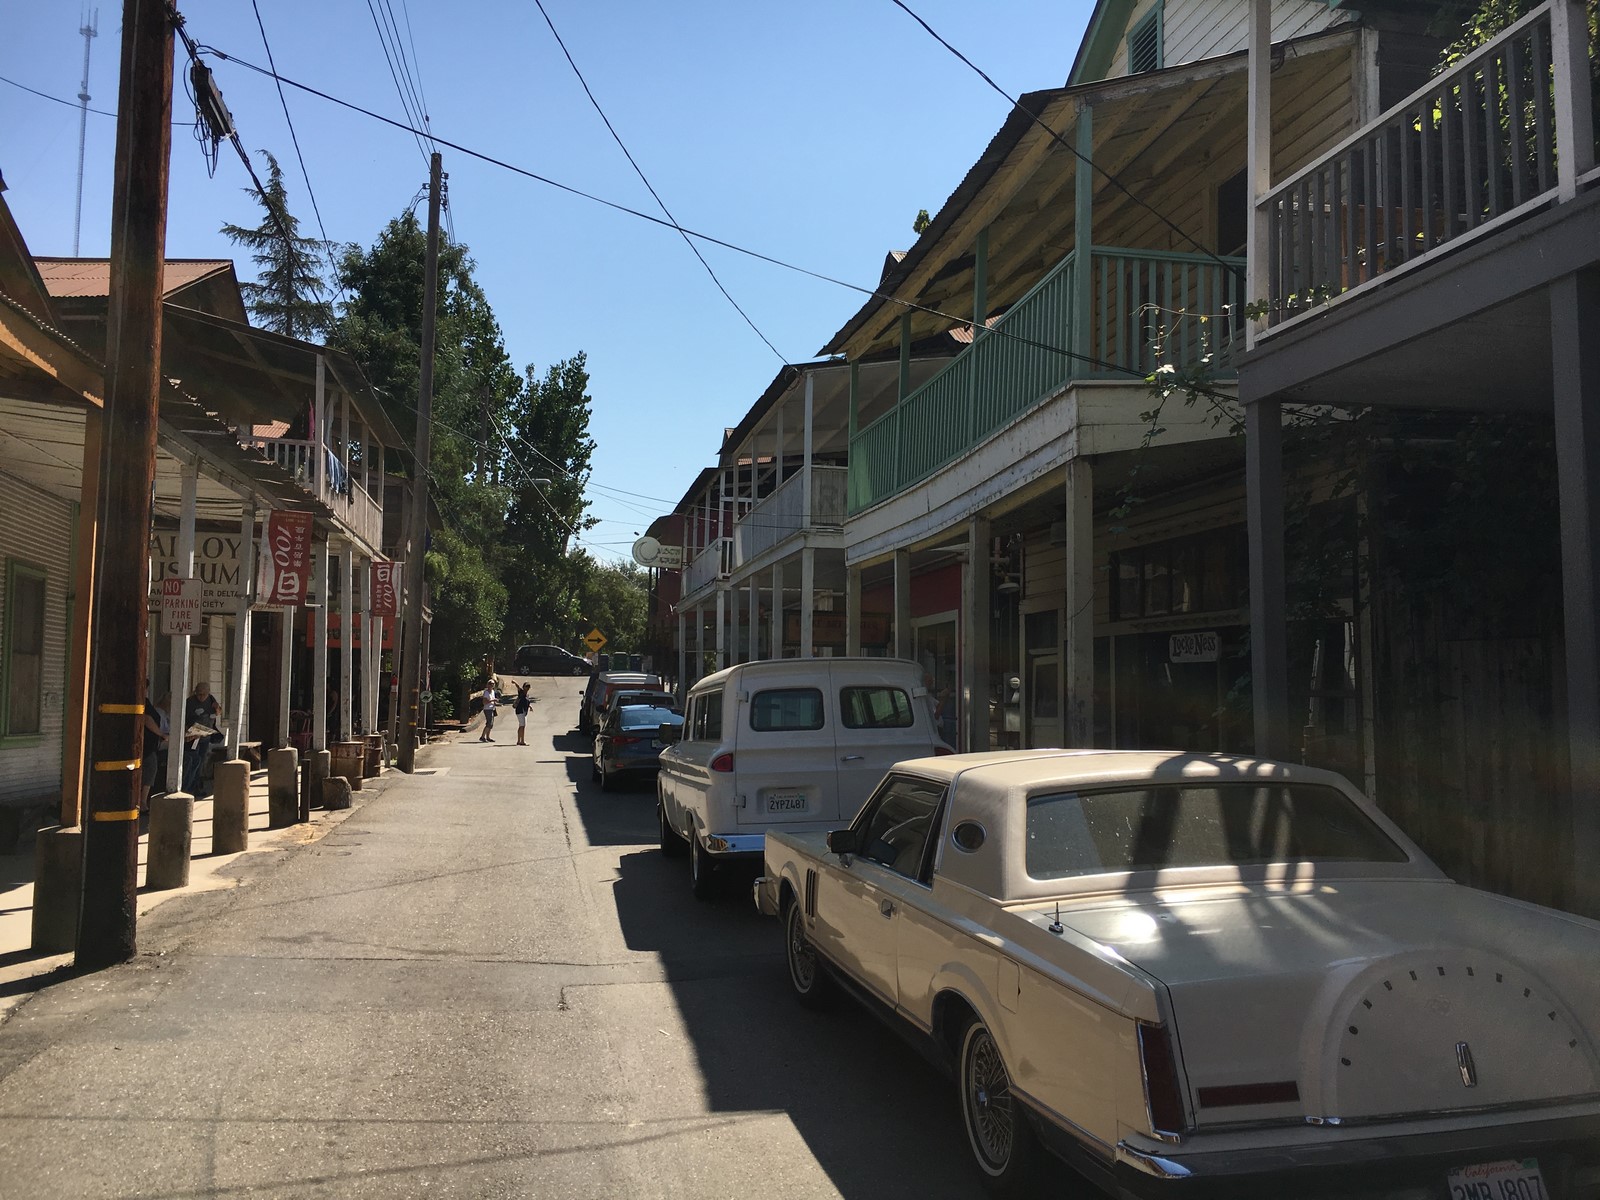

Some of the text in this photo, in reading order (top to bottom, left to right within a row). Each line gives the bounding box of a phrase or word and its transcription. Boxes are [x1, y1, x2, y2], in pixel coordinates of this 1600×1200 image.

[151, 534, 176, 557] AI
[275, 525, 292, 567] 100
[165, 581, 179, 593] NO
[383, 584, 393, 608] 100
[165, 598, 199, 609] PARKING
[172, 611, 191, 619] FIRE
[170, 622, 192, 630] LANE
[770, 799, 805, 809] 2YPZ487
